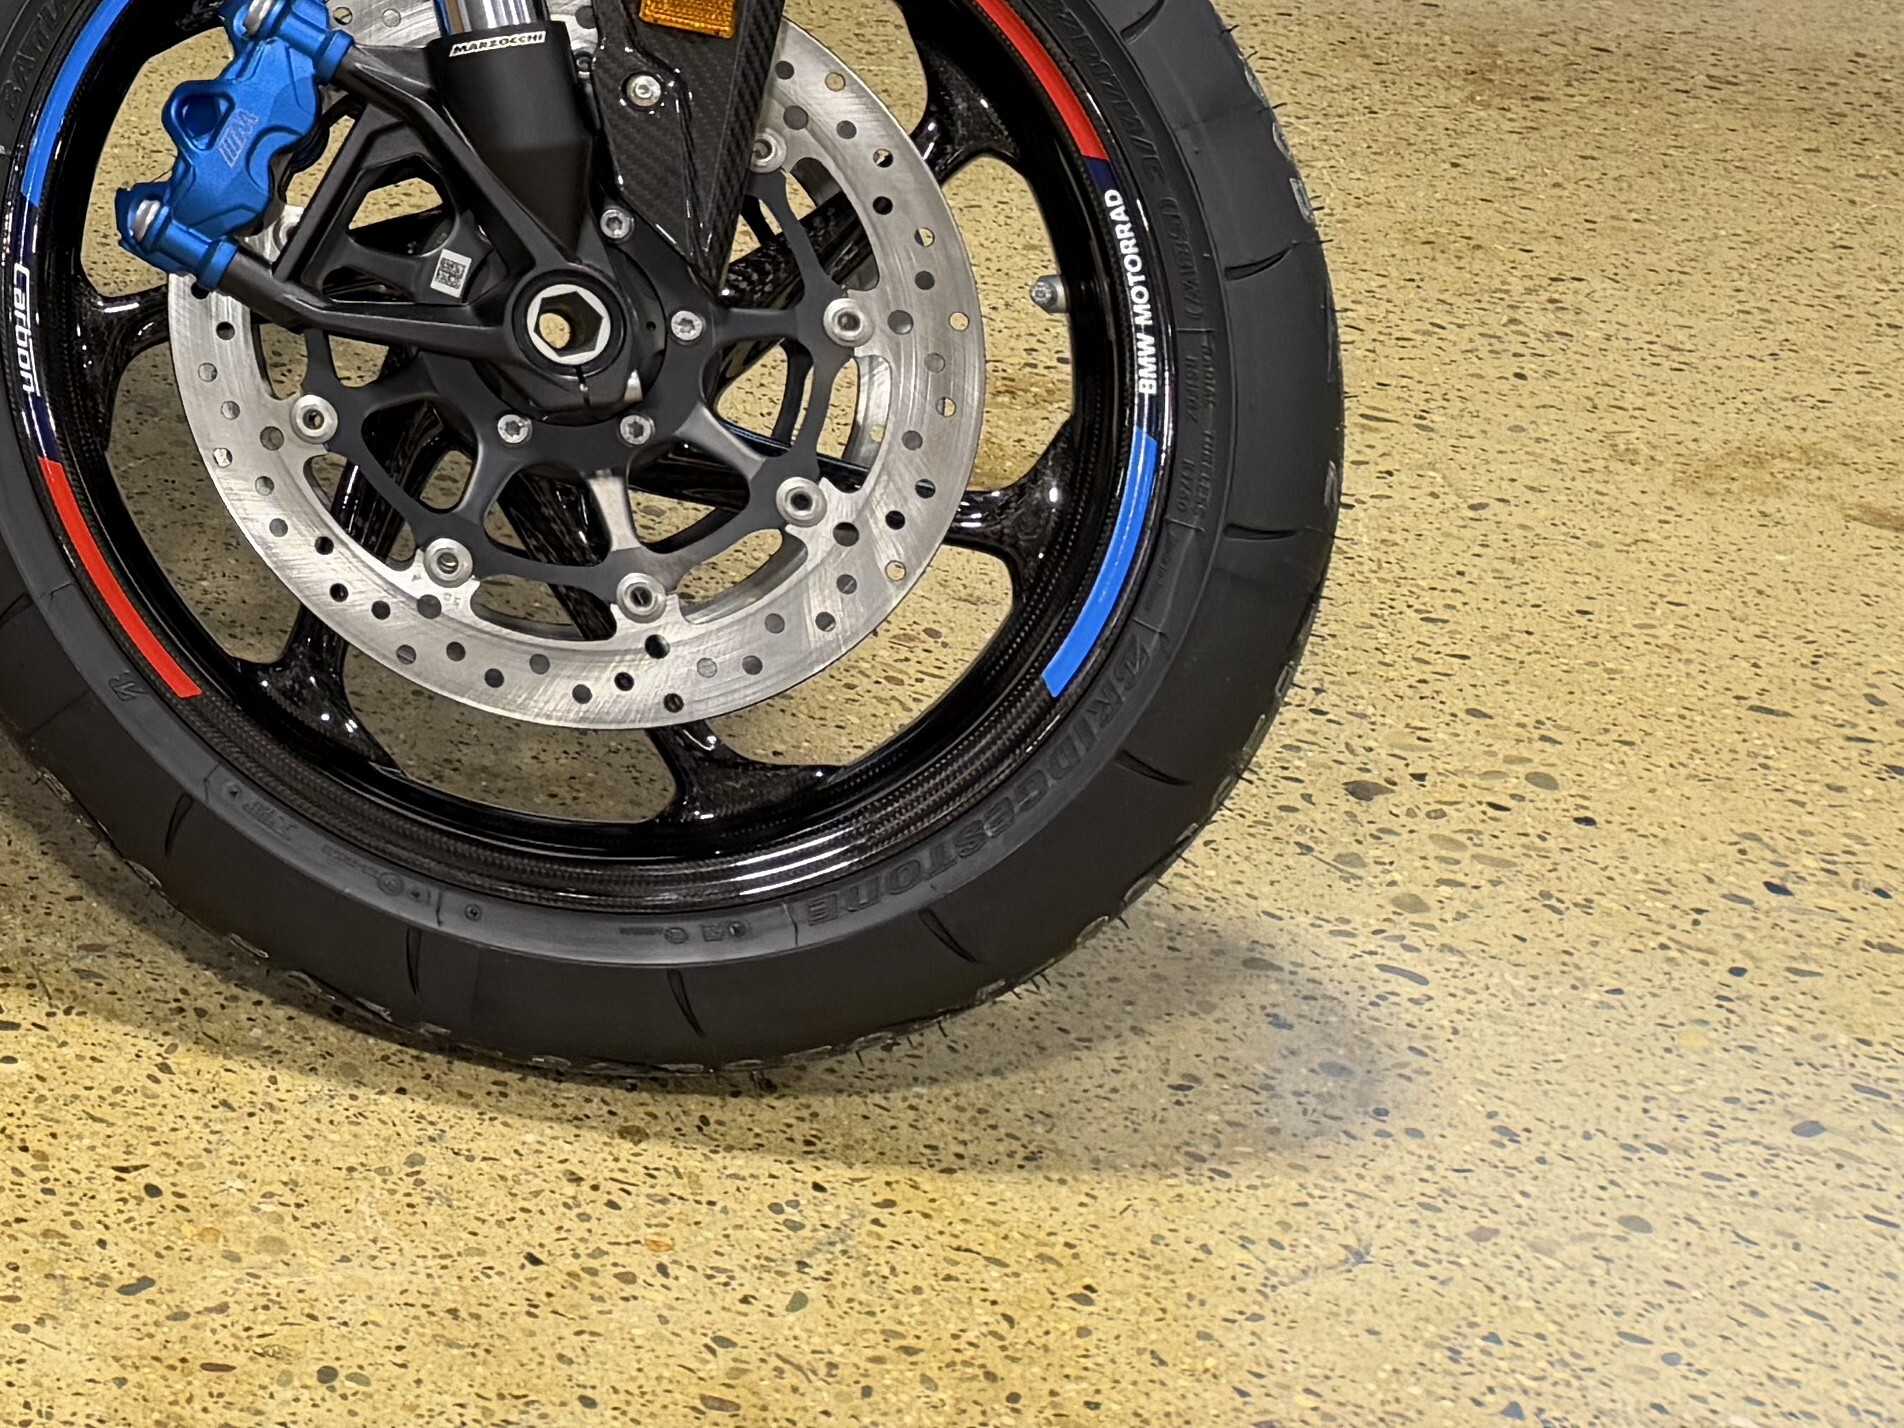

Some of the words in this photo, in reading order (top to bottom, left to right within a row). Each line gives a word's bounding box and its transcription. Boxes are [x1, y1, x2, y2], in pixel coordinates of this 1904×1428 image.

[451, 33, 545, 55] MARZOCCHI
[1104, 189, 1152, 328] MOTORRAD
[12, 262, 40, 397] Carbon
[1136, 331, 1158, 396] BMW
[804, 633, 1154, 928] BRIDGESTONE
